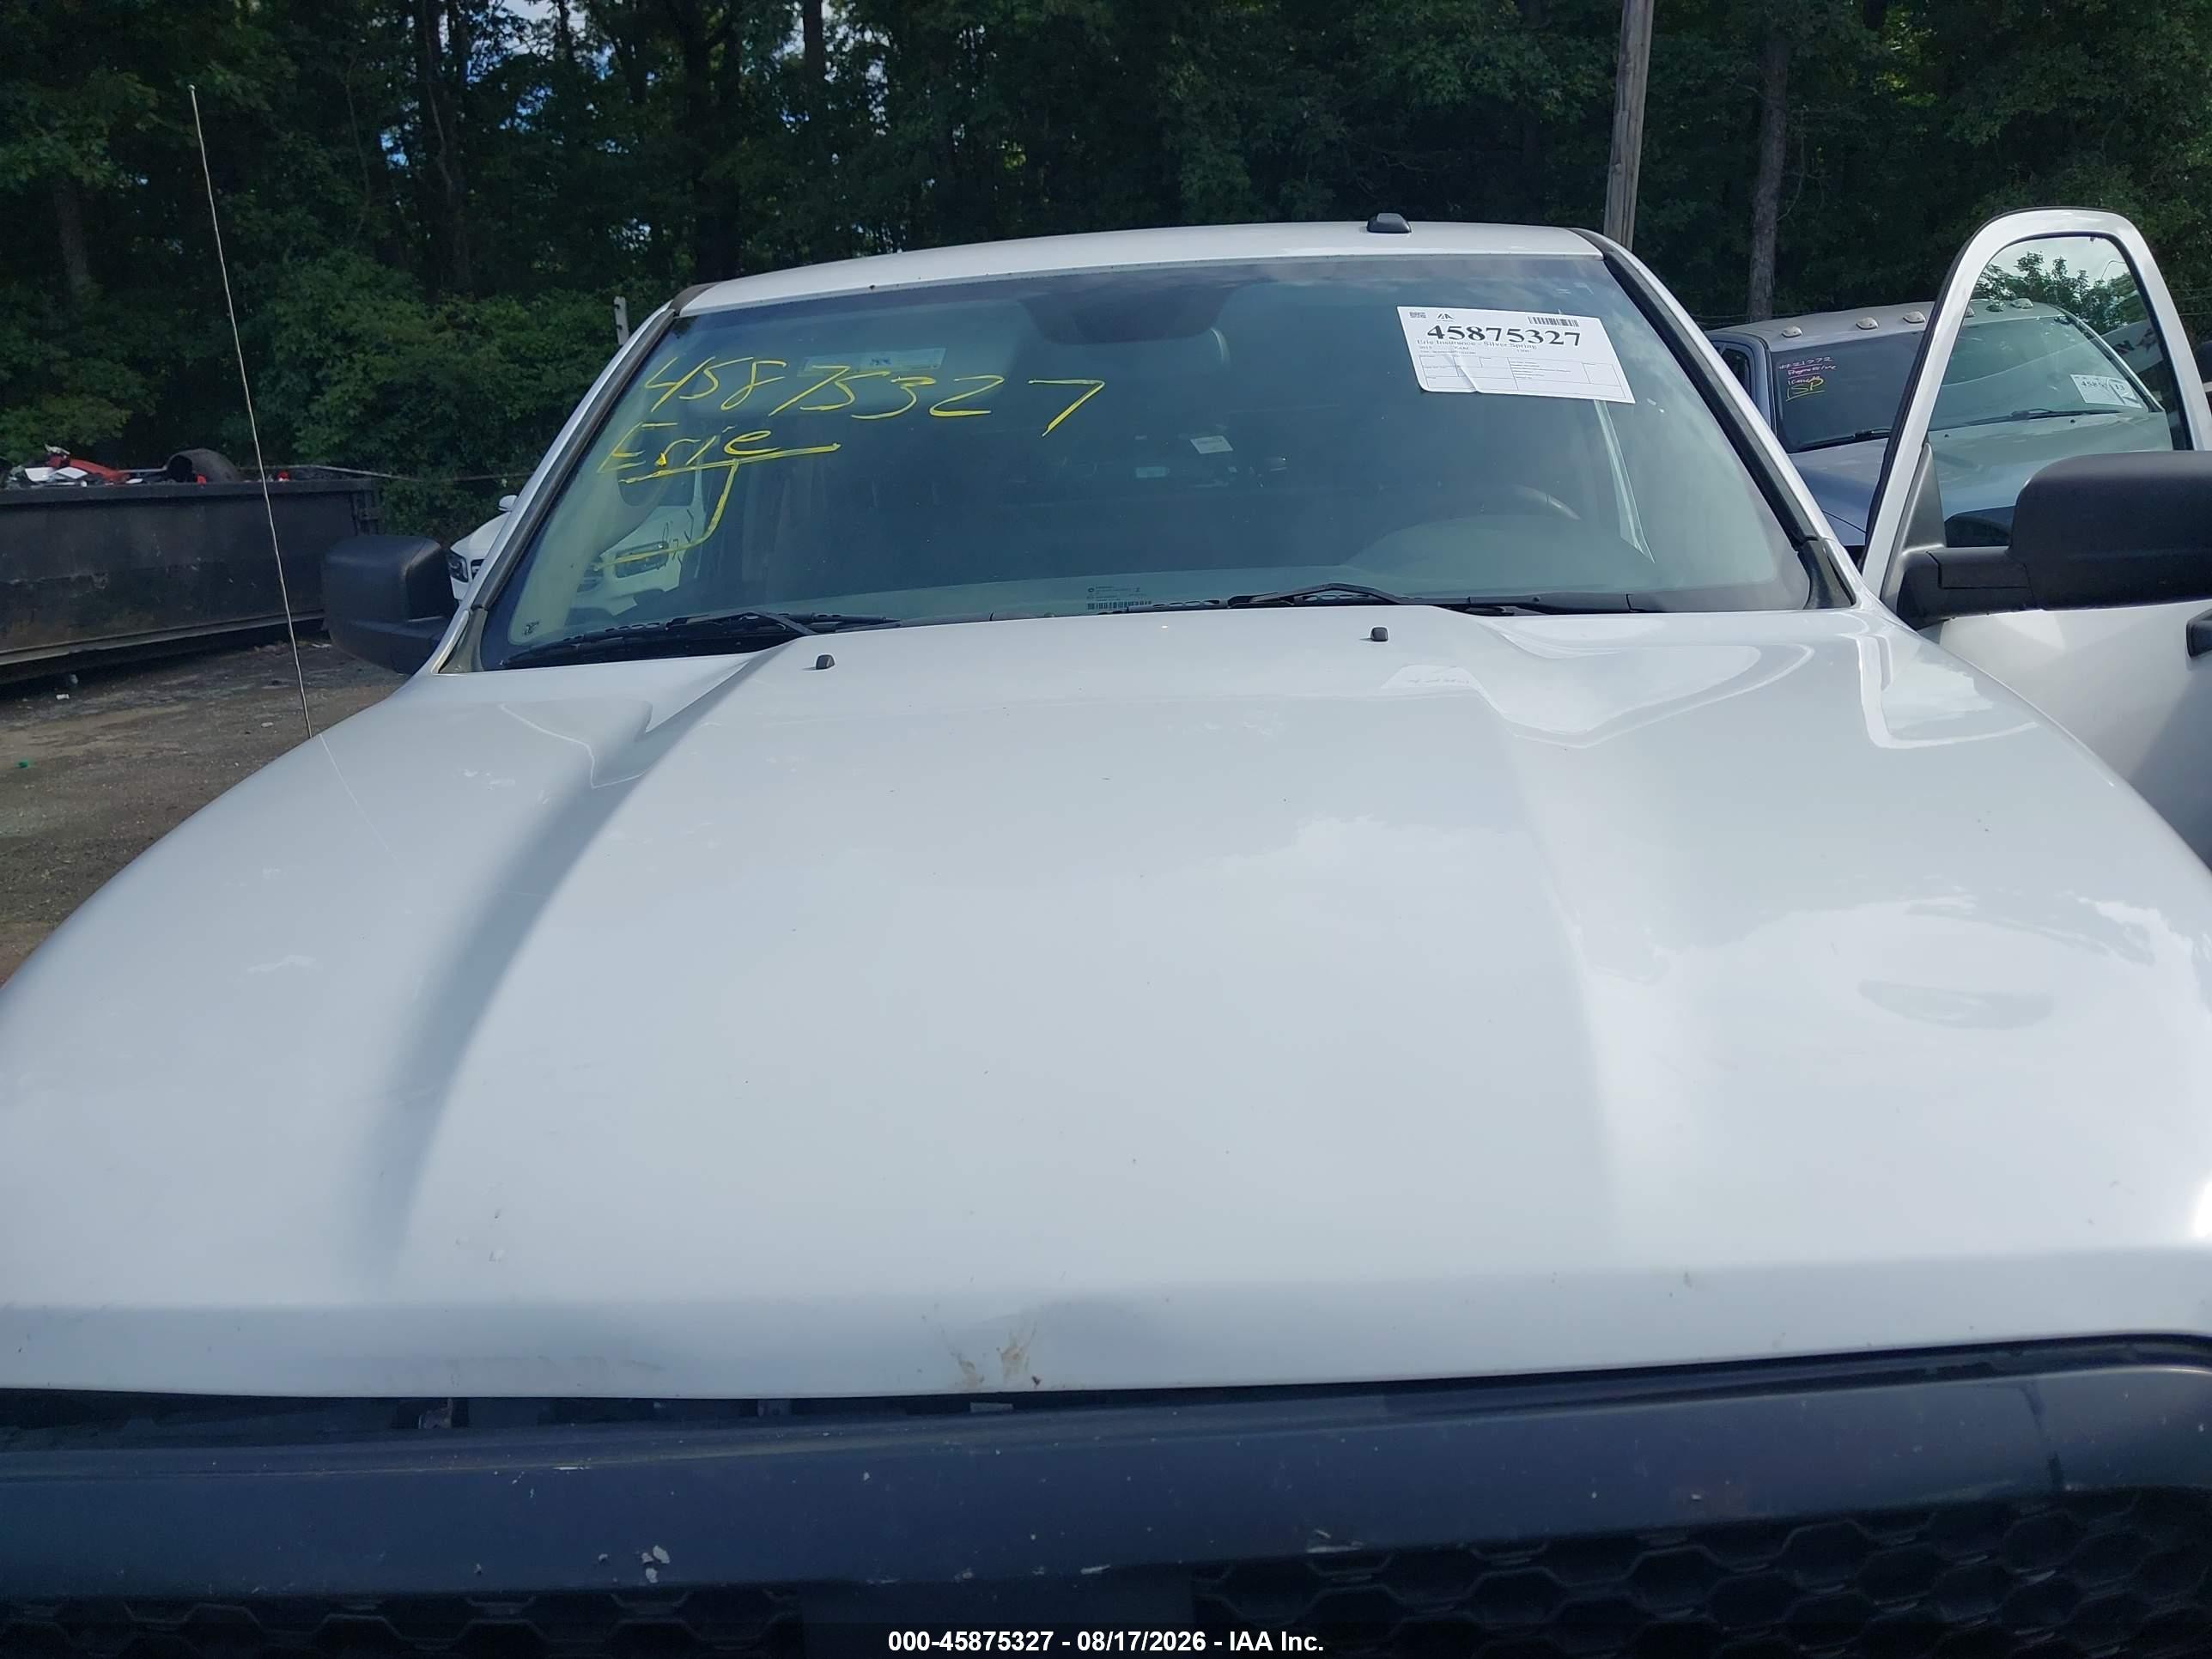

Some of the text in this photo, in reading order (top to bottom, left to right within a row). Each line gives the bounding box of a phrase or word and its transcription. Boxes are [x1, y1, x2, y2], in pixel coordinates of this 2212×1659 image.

[1426, 325, 1580, 346] 45875327
[644, 356, 1106, 438] 45875327
[597, 421, 782, 474] Erie
